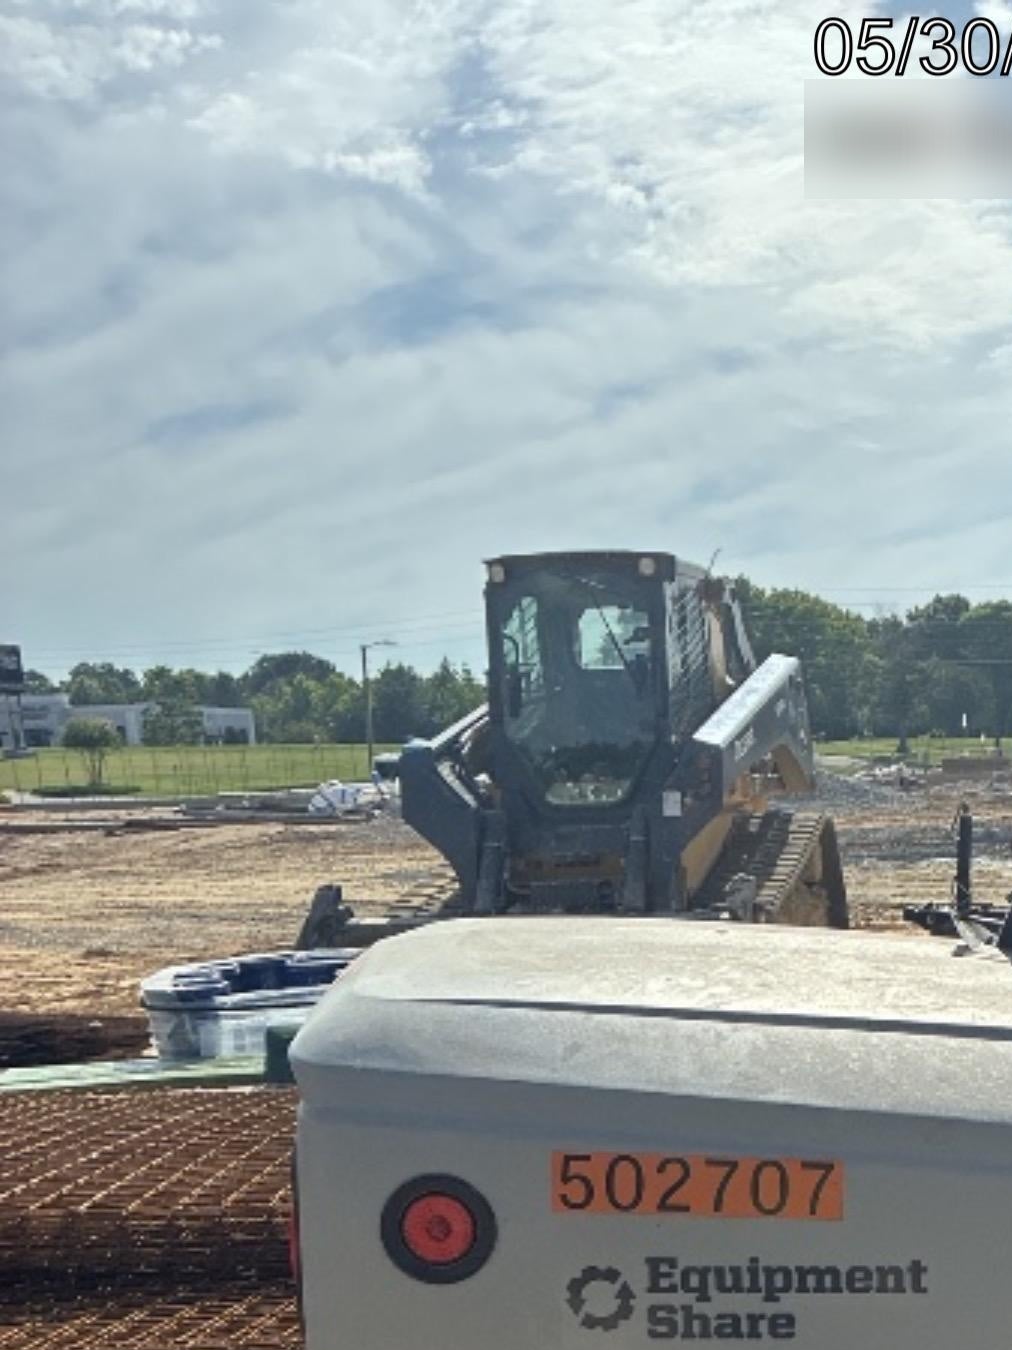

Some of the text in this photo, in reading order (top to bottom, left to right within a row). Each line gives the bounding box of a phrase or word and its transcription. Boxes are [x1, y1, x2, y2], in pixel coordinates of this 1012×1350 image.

[558, 1153, 835, 1216] 502707
[644, 1256, 929, 1302] Equipment
[646, 1303, 796, 1340] Share
